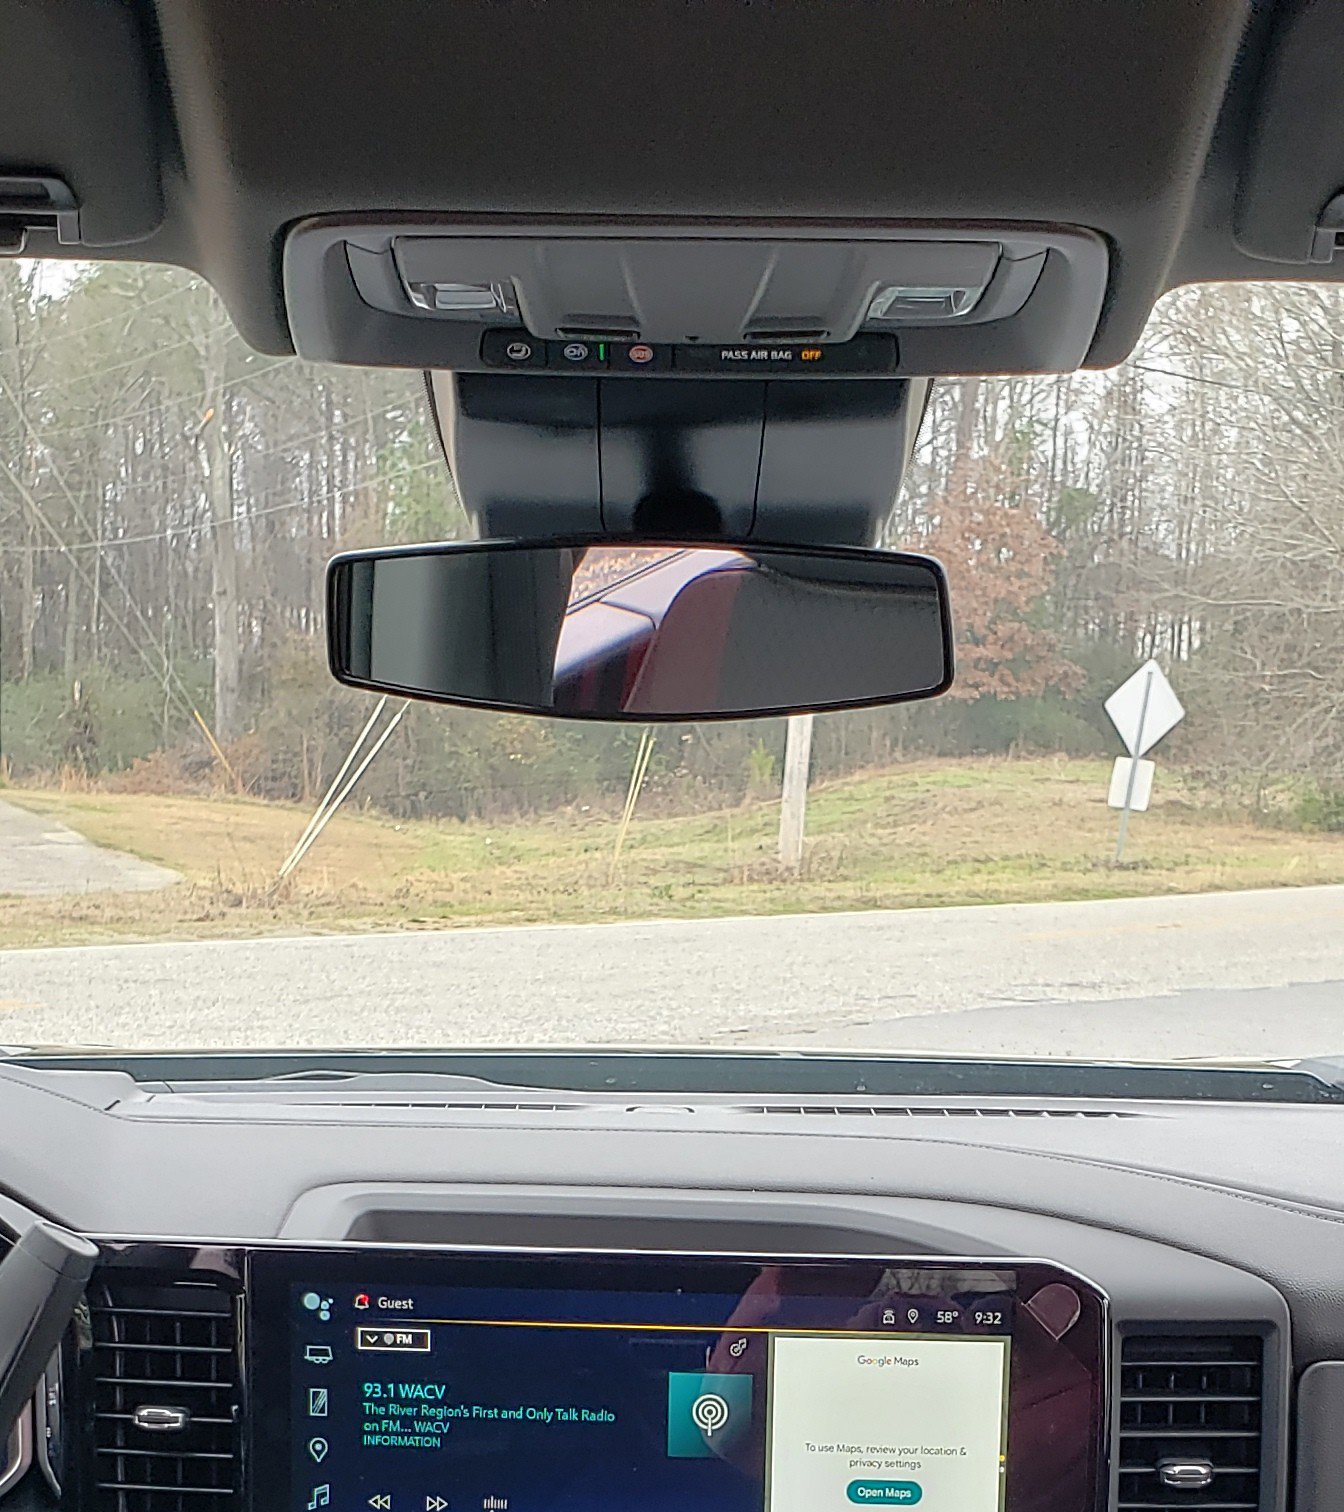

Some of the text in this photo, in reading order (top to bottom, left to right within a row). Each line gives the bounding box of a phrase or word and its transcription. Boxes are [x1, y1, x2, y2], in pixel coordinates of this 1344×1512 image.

[721, 351, 822, 360] PASS AIR BAG OFF
[378, 1297, 414, 1310] Guest
[937, 1311, 1002, 1325] 58° 9:32
[396, 1334, 413, 1345] FM
[858, 1355, 919, 1367] Google Maps
[364, 1383, 446, 1399] 93.1 WACV
[363, 1403, 615, 1422] The River Region's First and Only Talk Radio
[364, 1421, 450, 1433] on FM... WACV
[363, 1435, 441, 1447] INFORMATION
[806, 1443, 816, 1452] To
[837, 1444, 864, 1455] Maps,
[898, 1448, 918, 1456] your
[921, 1446, 957, 1455] location
[849, 1459, 921, 1470] privacy settings
[858, 1488, 911, 1498] Open Maps
